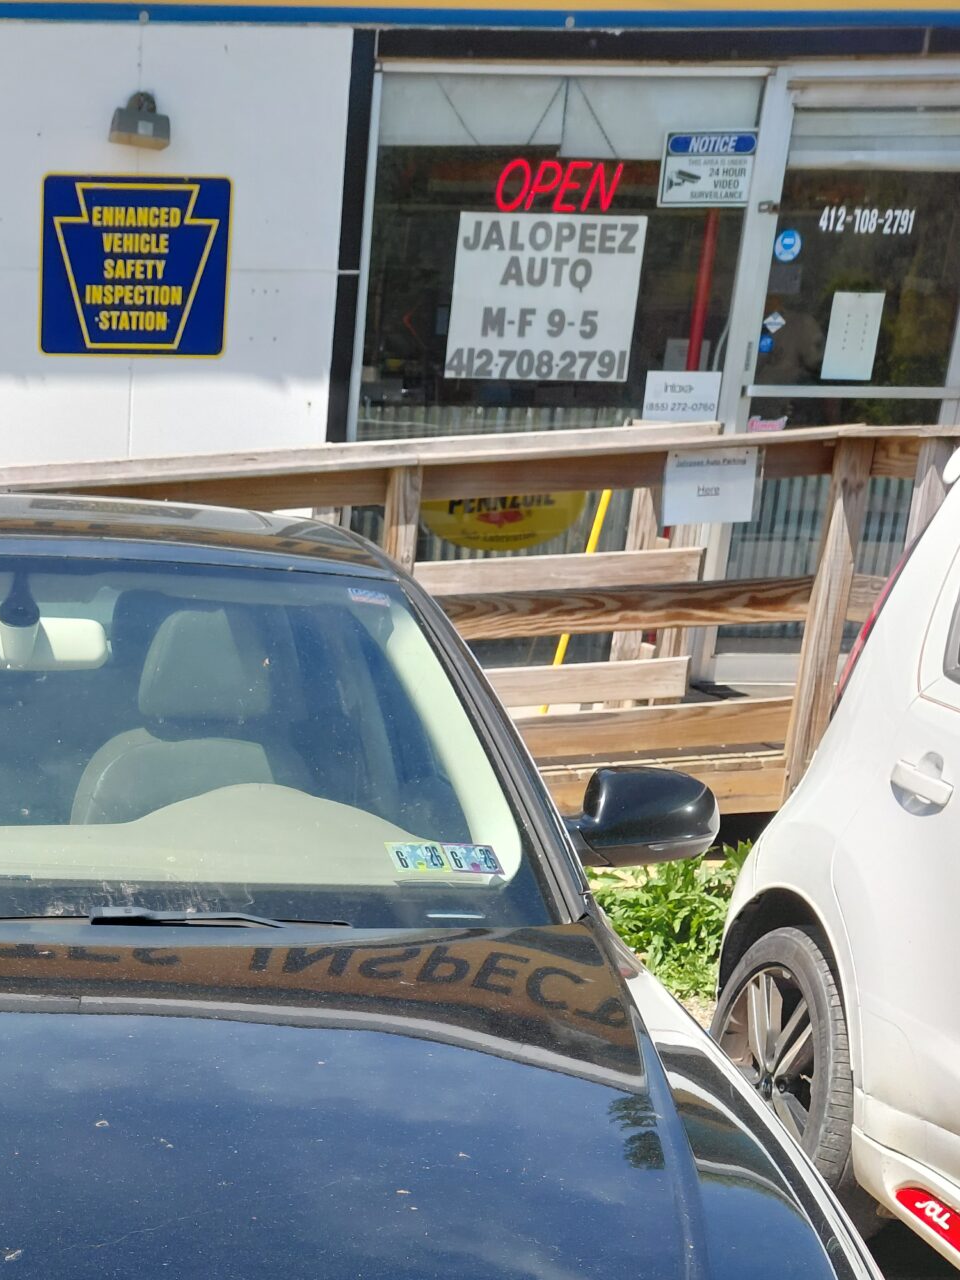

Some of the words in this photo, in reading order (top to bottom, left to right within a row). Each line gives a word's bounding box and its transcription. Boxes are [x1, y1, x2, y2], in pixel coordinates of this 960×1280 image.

[688, 136, 738, 153] NOTICE
[709, 168, 720, 177] 24
[722, 168, 746, 177] HOUR
[495, 158, 624, 212] OPEN
[713, 179, 740, 189] VIDEO
[690, 191, 743, 200] SURVEILLANCE
[92, 206, 181, 228] ENHANCED
[102, 232, 169, 254] VEHICLE
[462, 221, 639, 254] JALOPEEZ
[103, 259, 166, 279] SAFETY
[85, 285, 182, 306] INSPECTION
[98, 311, 168, 331] STATION
[481, 307, 536, 338] M-F
[546, 309, 598, 339] 9-5
[697, 485, 720, 496] Here
[395, 850, 409, 868] 6
[425, 846, 444, 866] 26
[450, 851, 463, 868] 6
[479, 848, 498, 869] 26
